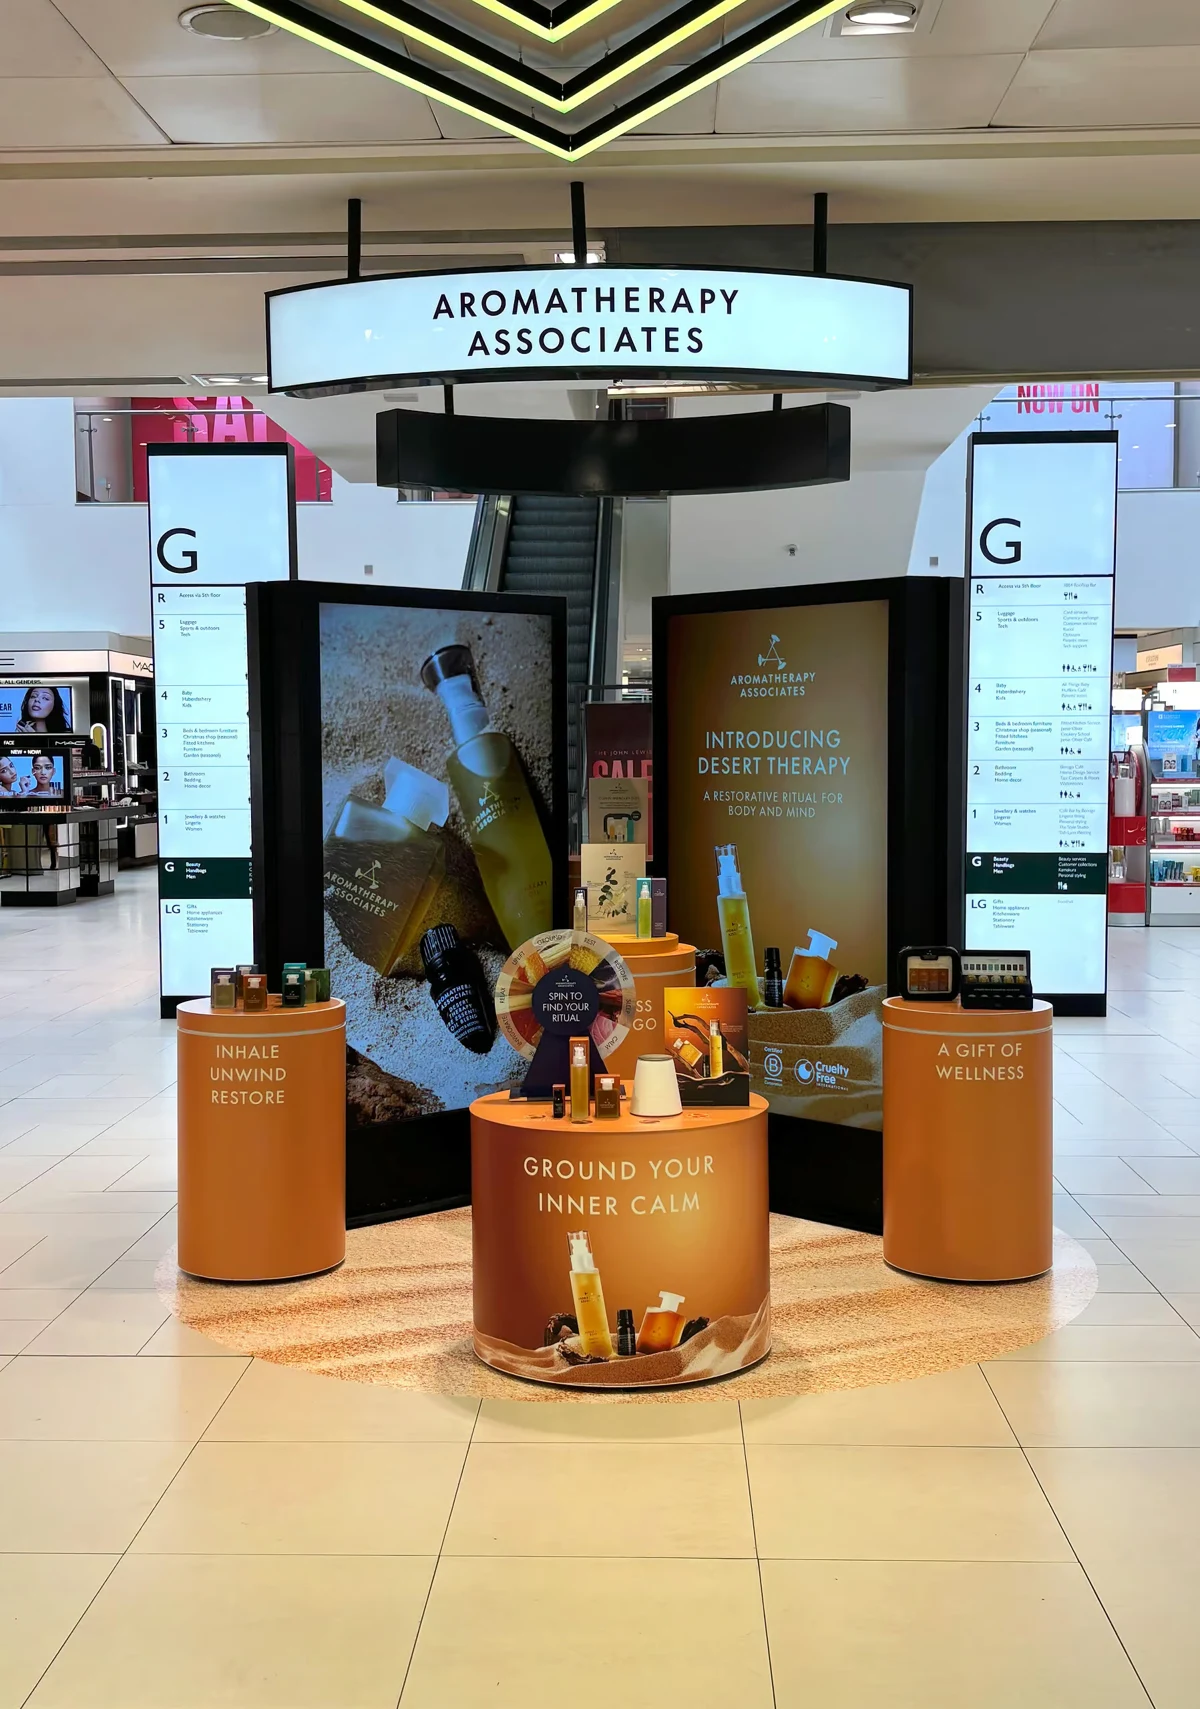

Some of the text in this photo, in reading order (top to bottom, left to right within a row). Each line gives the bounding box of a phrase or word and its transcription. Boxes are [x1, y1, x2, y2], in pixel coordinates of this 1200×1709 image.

[433, 288, 738, 320] AROMATHERAPY
[468, 327, 703, 356] ASSOCIATES
[1018, 383, 1099, 414] NOW ON
[980, 518, 1021, 564] G
[157, 528, 197, 574] G
[976, 585, 984, 594] R
[158, 593, 166, 602] R
[976, 612, 982, 621] 5
[159, 620, 165, 629] 5
[730, 672, 816, 685] AROMATHERAPY
[740, 686, 806, 698] ASSOCIATES
[975, 684, 981, 692] 4
[161, 691, 168, 700] 4
[974, 722, 980, 731] 3
[162, 729, 168, 738] 3
[706, 729, 841, 749] INTRODUCING
[698, 756, 850, 775] DESERT THERAPY
[973, 766, 980, 775] 2
[163, 772, 170, 781] 2
[703, 791, 843, 804] A RESTORATIVE RITUAL FOR
[728, 806, 815, 818] BODY AND MIND
[973, 809, 976, 818] 1
[164, 815, 168, 824] 1
[165, 862, 174, 872] G
[972, 856, 982, 866] G
[324, 871, 399, 911] AROMATHERAPY
[335, 888, 386, 917] SSOCIATES
[972, 900, 986, 908] LG
[166, 904, 180, 914] LG
[584, 937, 596, 946] REST
[512, 951, 525, 966] UPLIFT
[614, 960, 628, 981] RESTORE
[549, 992, 582, 1000] SPIN TO
[542, 1002, 590, 1011] FIND YOUR
[552, 1013, 580, 1022] RITUAL
[633, 1018, 656, 1030] GO
[605, 1036, 618, 1050] CALM
[216, 1045, 279, 1059] INHALE
[764, 1046, 782, 1054] Certified
[938, 1043, 1022, 1057] A GIFT OF
[769, 1058, 778, 1072] B
[816, 1061, 849, 1077] Cruelty
[210, 1067, 287, 1082] UNWIND
[816, 1072, 836, 1084] Free
[936, 1065, 1024, 1081] WELLNESS
[211, 1090, 285, 1105] RESTORE
[523, 1155, 714, 1181] GROUND YOUR
[538, 1192, 700, 1215] INNER CALM
